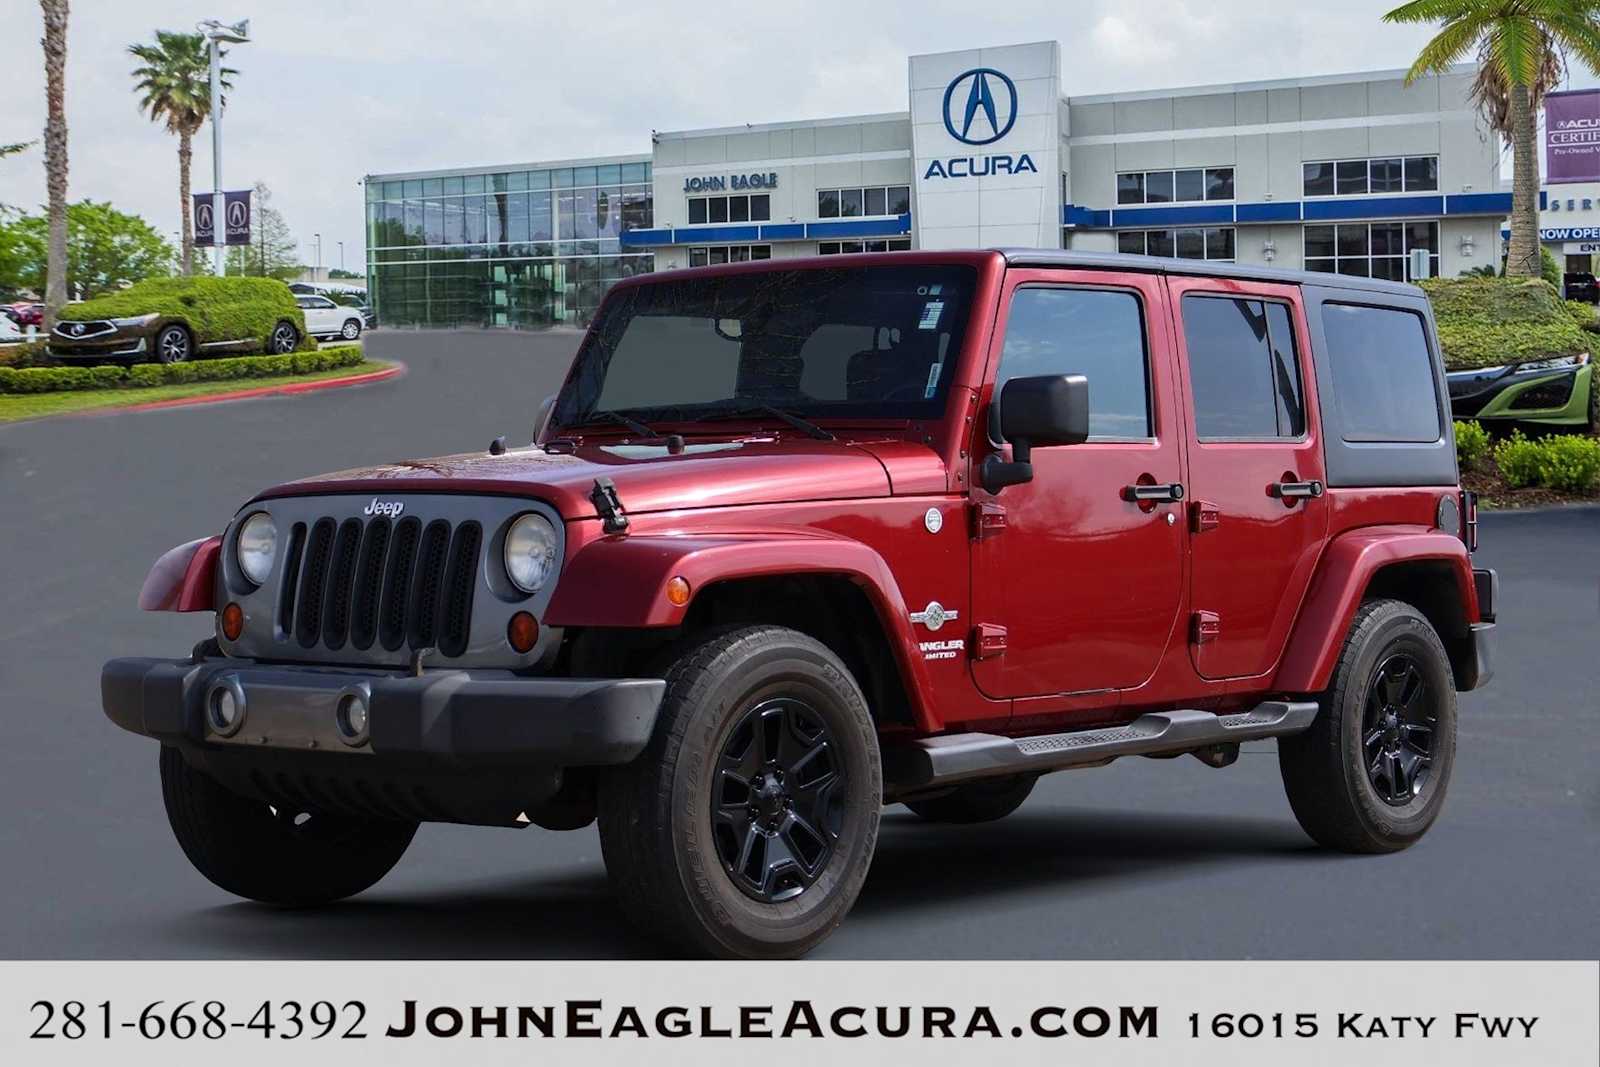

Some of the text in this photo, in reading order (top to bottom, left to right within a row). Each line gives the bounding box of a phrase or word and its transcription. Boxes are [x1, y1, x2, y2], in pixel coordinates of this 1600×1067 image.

[924, 153, 1038, 180] ACURA
[683, 172, 778, 192] JOHN EAGLE
[1572, 228, 1600, 238] OPE
[364, 497, 404, 518] Jeep
